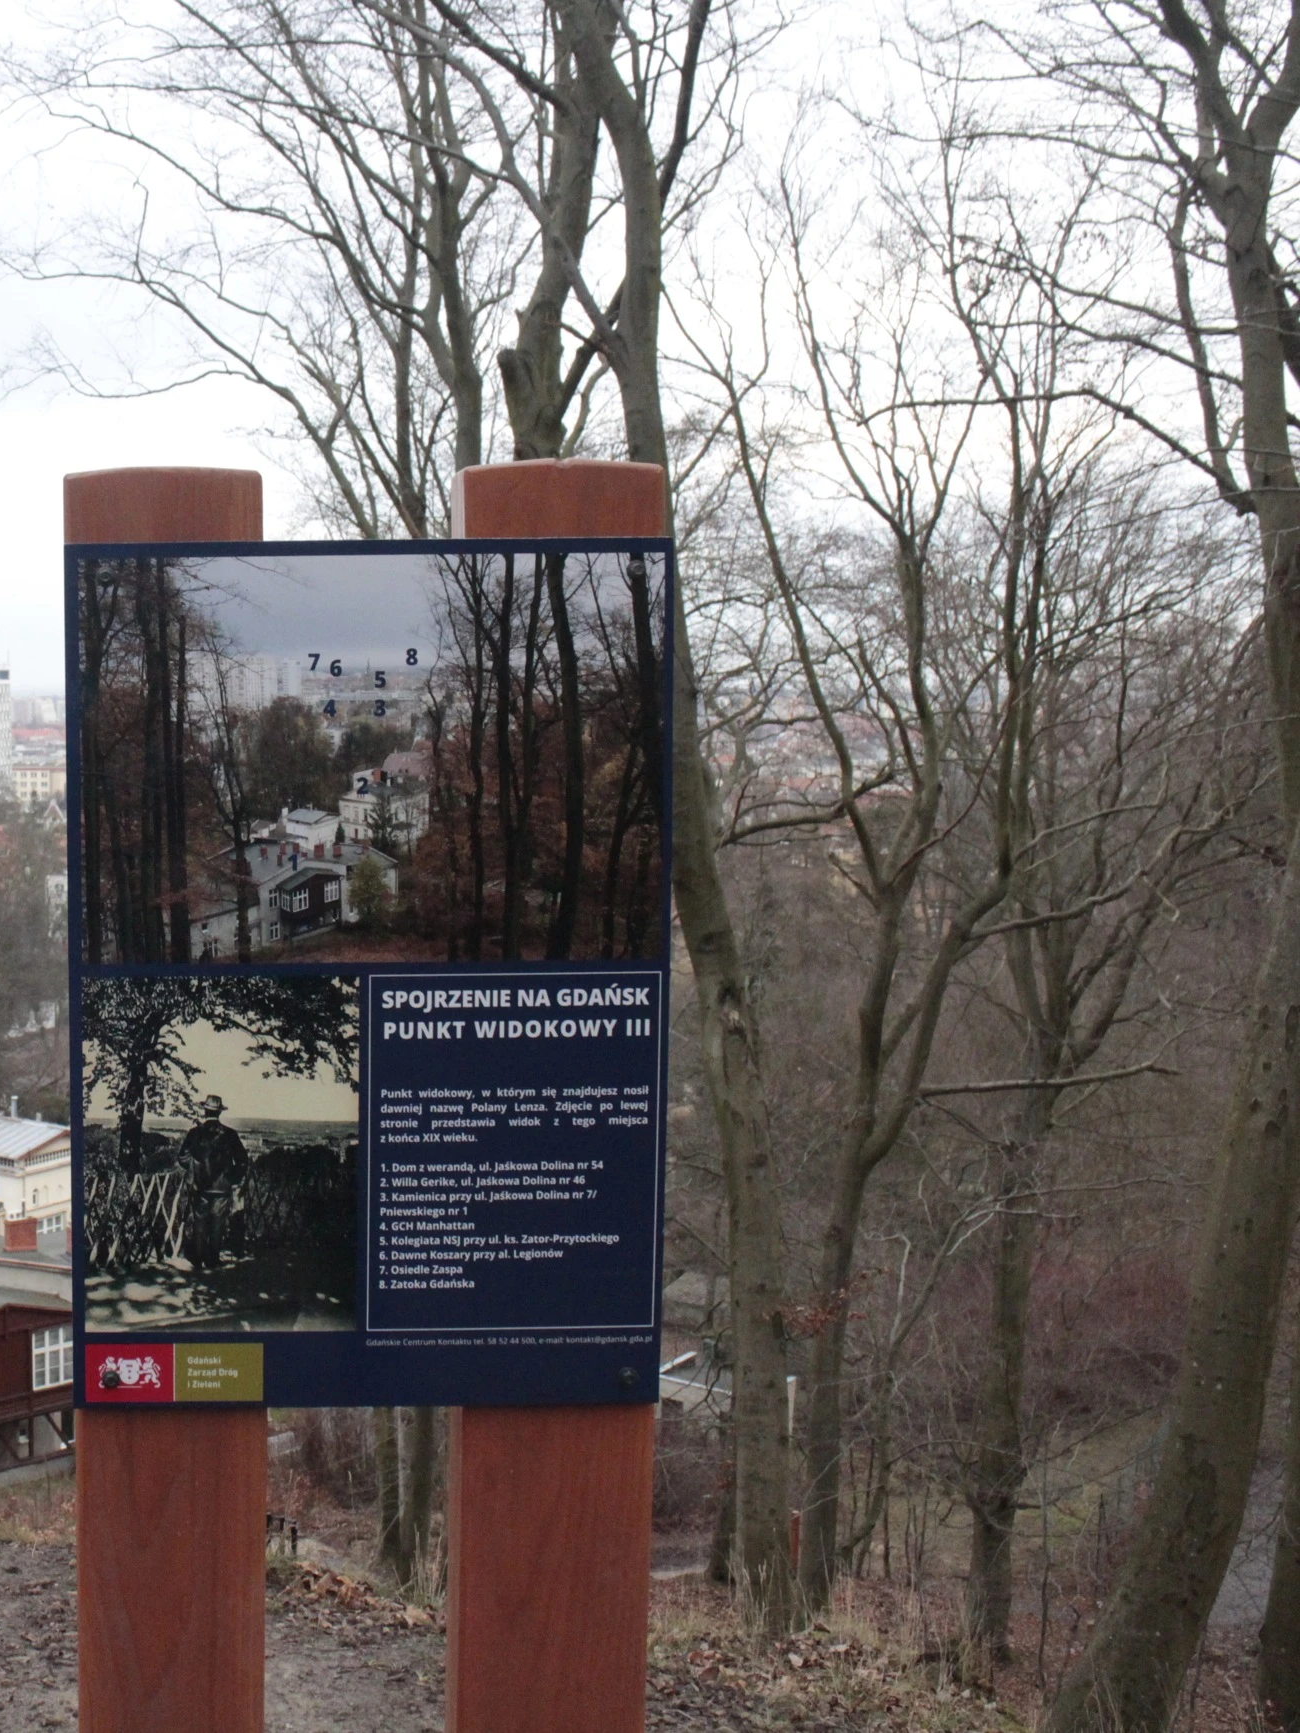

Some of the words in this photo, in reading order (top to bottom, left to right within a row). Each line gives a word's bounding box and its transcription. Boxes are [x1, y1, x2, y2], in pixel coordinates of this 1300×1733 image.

[308, 653, 320, 670] 7
[406, 648, 418, 665] 8
[330, 660, 342, 677] 6
[375, 671, 386, 688] 5
[323, 699, 337, 717] 4
[374, 699, 385, 716] 3
[356, 777, 368, 794] 2
[288, 854, 297, 871] 1
[382, 990, 511, 1013] SPOJRZENIE
[518, 989, 550, 1007] NA
[557, 983, 649, 1006] GDAŃSK
[384, 1021, 465, 1039] PUNKT
[474, 1019, 617, 1038] WIDOKOWY
[627, 1019, 650, 1036] III
[381, 1089, 412, 1098] Punkt
[419, 1088, 475, 1100] widokowy,
[497, 1088, 535, 1099] którym
[542, 1087, 556, 1098] się
[563, 1086, 617, 1098] znajdujesz
[624, 1085, 649, 1095] nosił
[381, 1103, 422, 1115] dawniej
[430, 1105, 463, 1114] nazwę
[472, 1103, 507, 1114] Polany
[515, 1103, 548, 1111] Lenza.
[555, 1101, 592, 1113] Zdjęcie
[600, 1103, 613, 1112] po
[621, 1100, 648, 1112] lewej
[381, 1118, 418, 1128] stronie
[432, 1118, 495, 1130] przedstawia
[509, 1117, 540, 1126] widok
[554, 1118, 559, 1126] z
[572, 1117, 595, 1128] tego
[609, 1115, 648, 1127] miejsca
[388, 1133, 420, 1142] końca
[423, 1133, 440, 1142] XIX
[443, 1133, 477, 1142] wieku.
[381, 1163, 389, 1172] 1.
[392, 1163, 416, 1172] Dom
[419, 1164, 424, 1172] z
[427, 1162, 476, 1174] werandą,
[479, 1162, 492, 1171] ul.
[494, 1161, 538, 1173] Jaśkowa
[541, 1161, 574, 1170] Dolina
[592, 1160, 603, 1169] 54
[380, 1178, 389, 1187] 2.
[392, 1177, 418, 1187] Willa
[421, 1177, 458, 1188] Gerike,
[461, 1177, 473, 1186] ul.
[476, 1176, 519, 1188] Jaśkowa
[523, 1176, 556, 1185] Dolina
[573, 1175, 585, 1184] 46
[380, 1193, 389, 1201] 3.
[392, 1192, 446, 1201] Kamienica
[449, 1194, 472, 1204] przy
[474, 1191, 487, 1200] ul.
[489, 1191, 533, 1202] Jaśkowa
[536, 1190, 570, 1199] Dolina
[587, 1190, 597, 1198] 7/
[380, 1207, 445, 1218] Pniewskiego
[463, 1206, 467, 1215] 1
[379, 1222, 388, 1230] 4.
[391, 1222, 413, 1231] GCH
[417, 1221, 474, 1230] Manhattan
[380, 1236, 388, 1245] 5.
[392, 1236, 440, 1247] Kolegiata
[443, 1236, 460, 1246] NSJ
[464, 1237, 486, 1248] przy
[489, 1235, 501, 1244] ul.
[504, 1235, 518, 1244] ks.
[521, 1233, 619, 1245] Zator-Przytockiego
[379, 1251, 388, 1260] 6.
[391, 1251, 427, 1260] Dawne
[430, 1251, 470, 1261] Koszary
[473, 1252, 496, 1262] przy
[498, 1249, 510, 1259] al.
[514, 1249, 563, 1260] Legionów
[379, 1266, 388, 1274] 7.
[391, 1265, 430, 1274] Osiedle
[432, 1265, 463, 1276] Zaspa
[379, 1280, 388, 1289] 8.
[391, 1280, 427, 1289] Zatoka
[430, 1279, 474, 1288] Gdańska
[366, 1338, 400, 1346] Gdańskie
[188, 1356, 220, 1364] Gdański
[188, 1368, 216, 1378] Zarząd
[219, 1368, 238, 1378] Dróg
